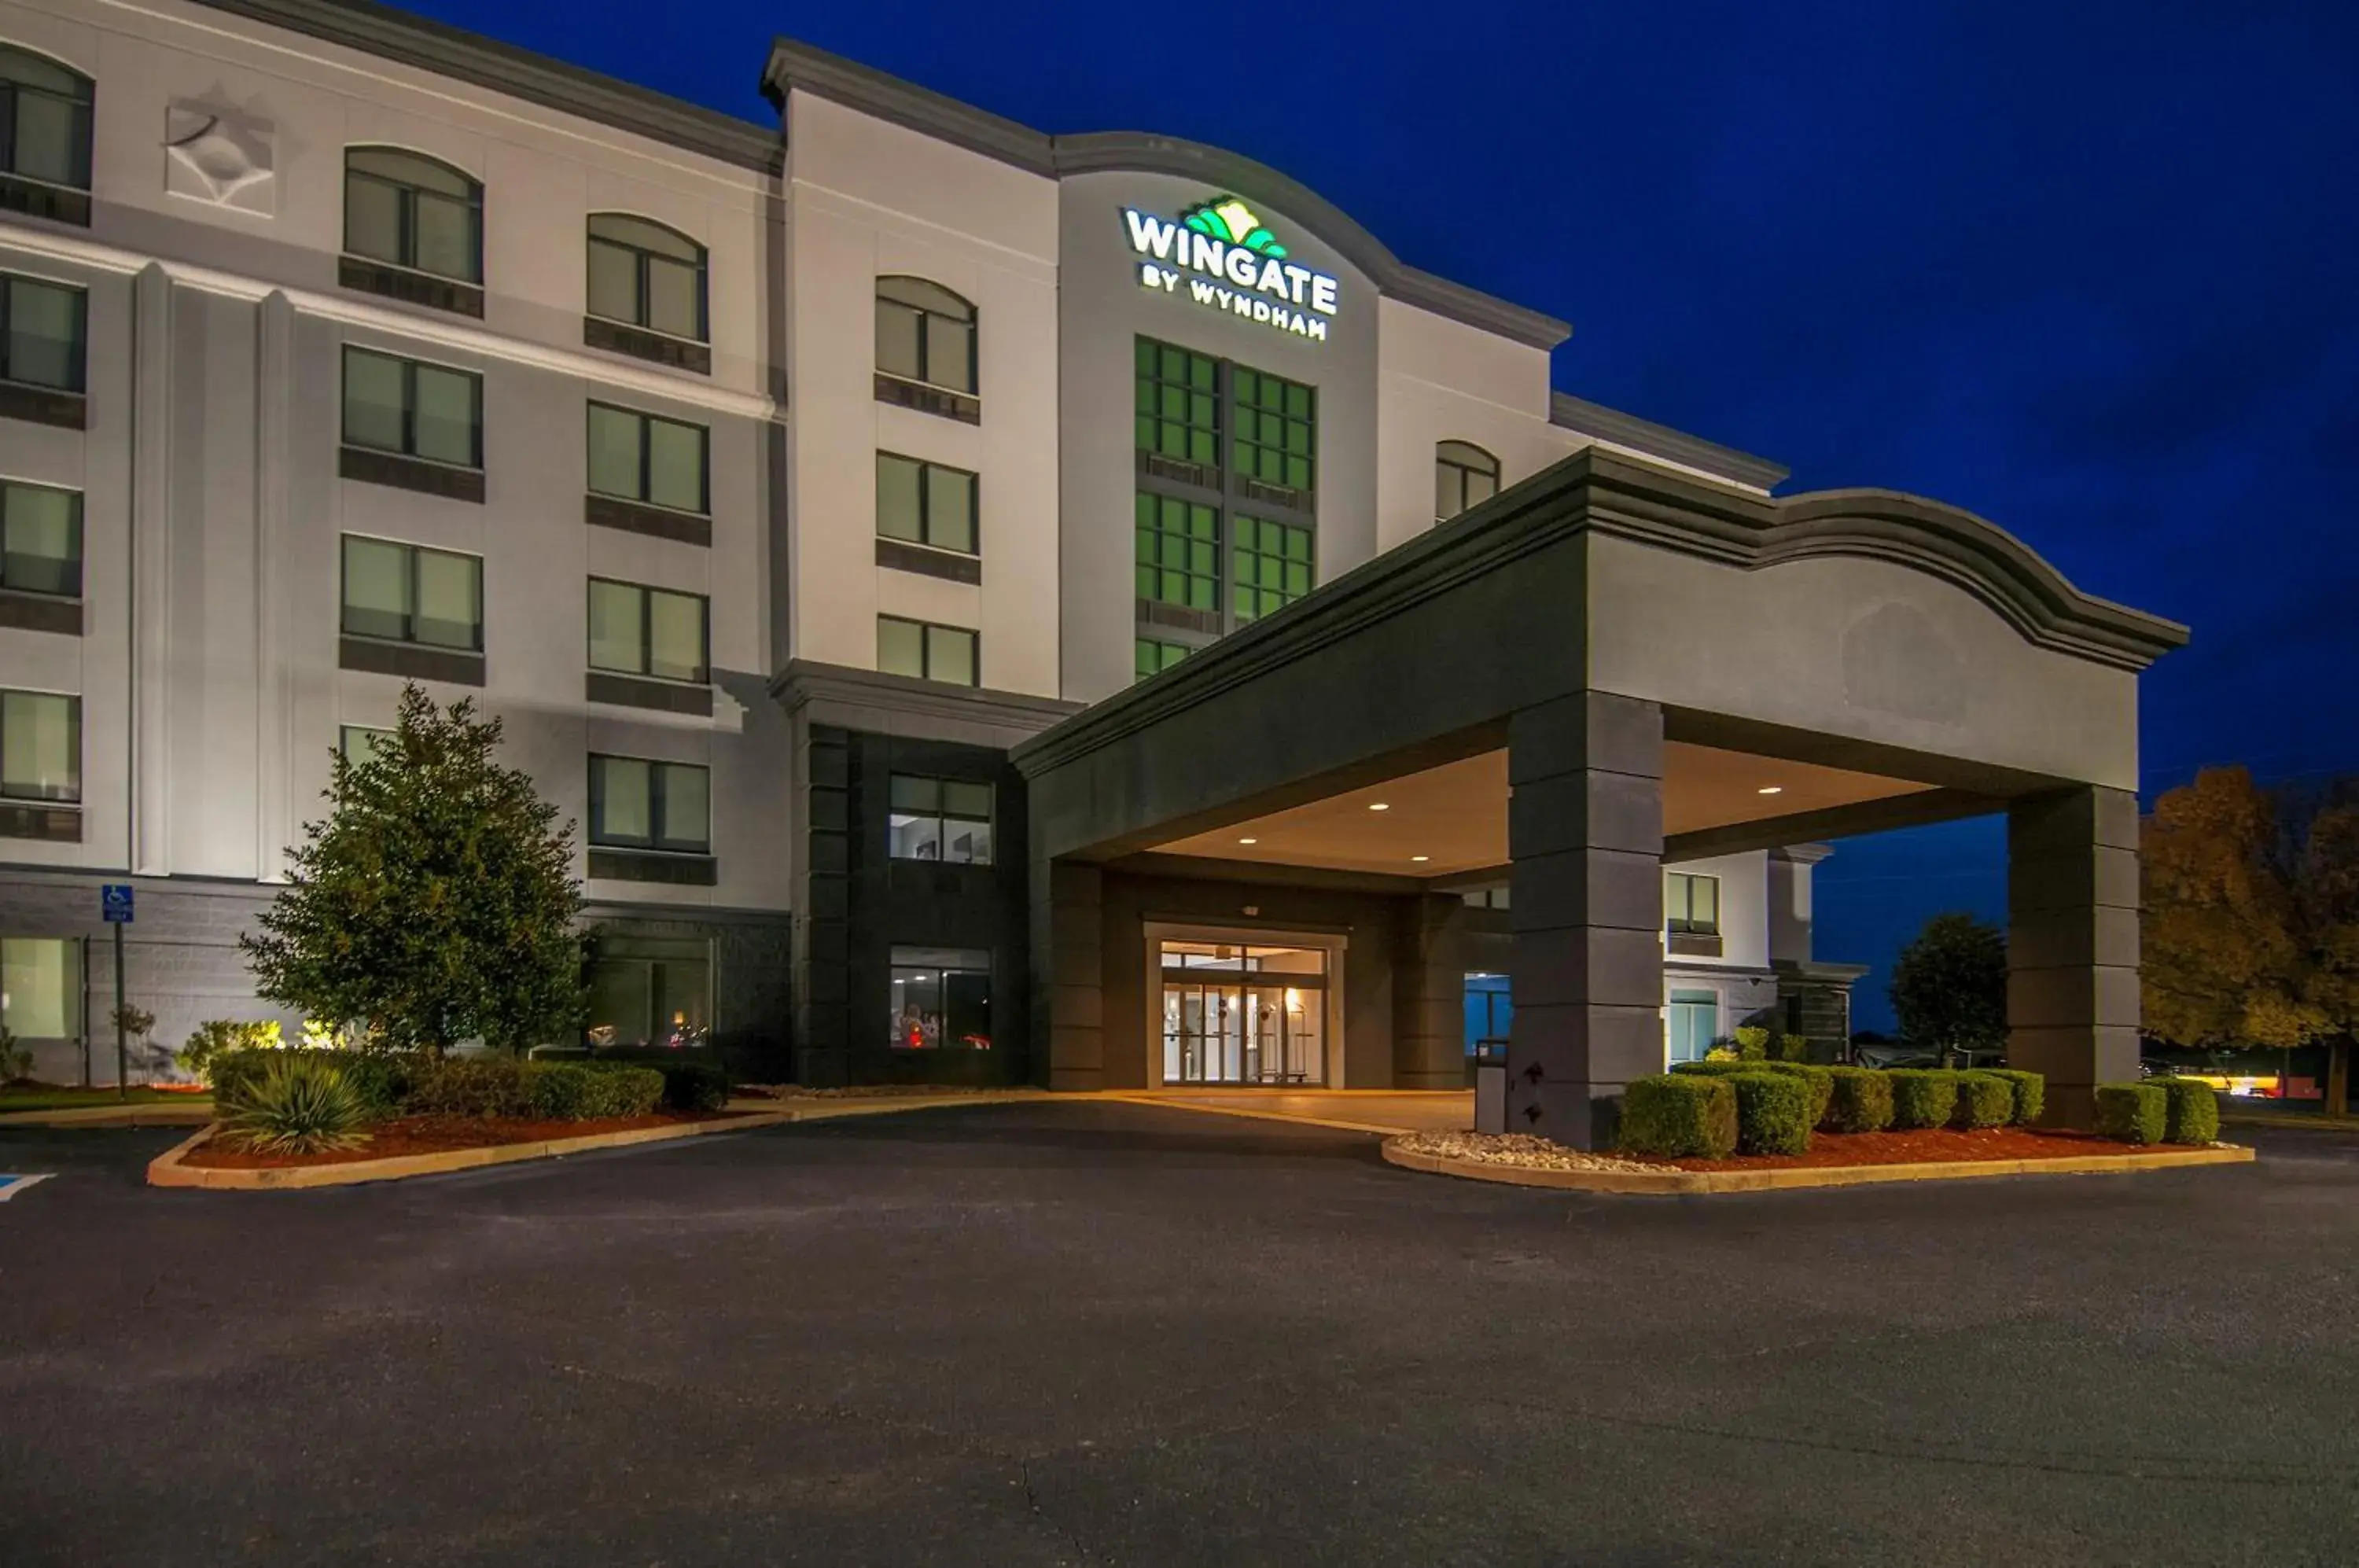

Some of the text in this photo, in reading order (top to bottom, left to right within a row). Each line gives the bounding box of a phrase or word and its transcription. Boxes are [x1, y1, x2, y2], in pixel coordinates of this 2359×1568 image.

[1126, 210, 1337, 315] WINGATE
[1143, 264, 1327, 340] BY WYNDHAM
